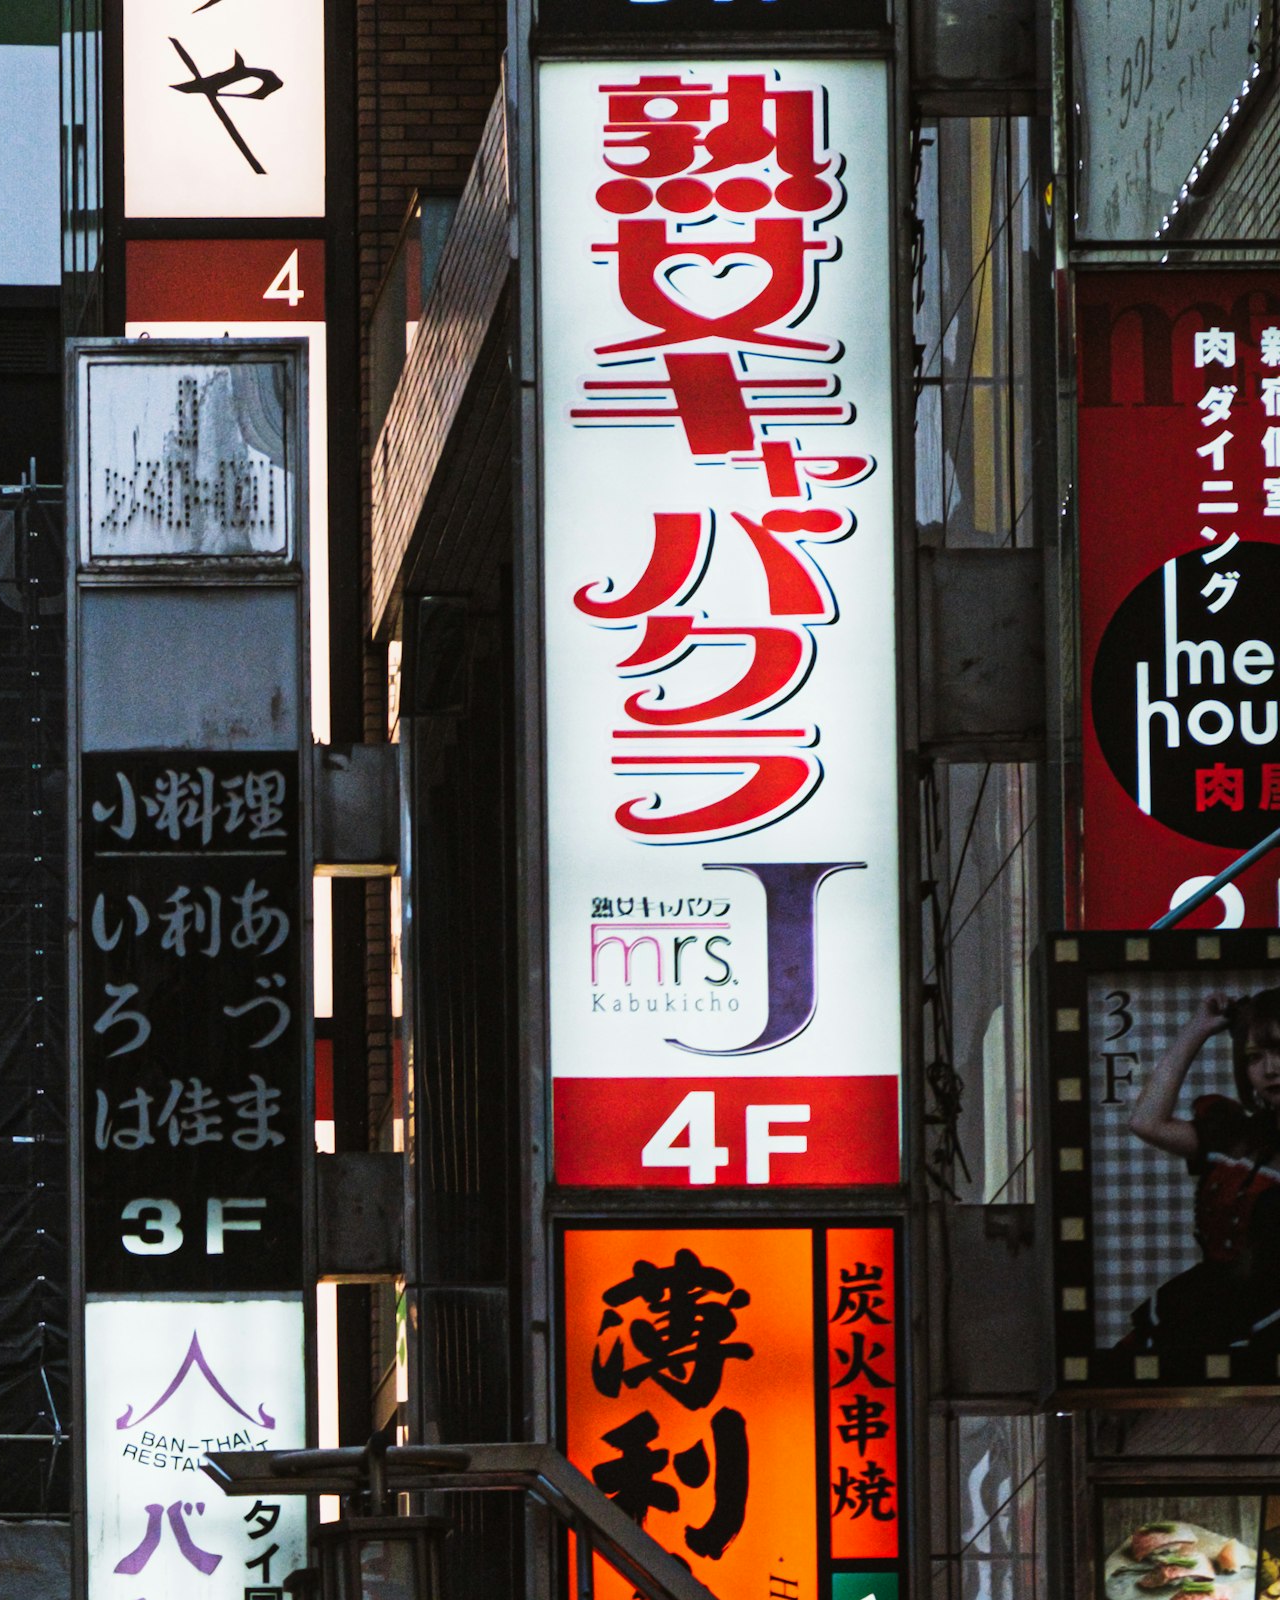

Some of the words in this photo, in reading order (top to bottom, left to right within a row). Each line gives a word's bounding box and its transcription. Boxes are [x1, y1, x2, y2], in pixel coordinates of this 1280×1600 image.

[262, 247, 305, 307] 4
[569, 72, 876, 836] 熟女キャバクラ
[1194, 327, 1240, 614] 肉ダイニング
[91, 766, 289, 846] 小料理
[591, 897, 731, 919] 熟女キャバクラ
[91, 892, 156, 1152] いろは
[591, 993, 740, 1013] Kabukicho
[641, 1090, 811, 1185] 4F
[121, 1197, 268, 1256] 3F
[829, 1261, 897, 1523] 炭火串焼
[140, 1429, 252, 1454] BAN-THAI
